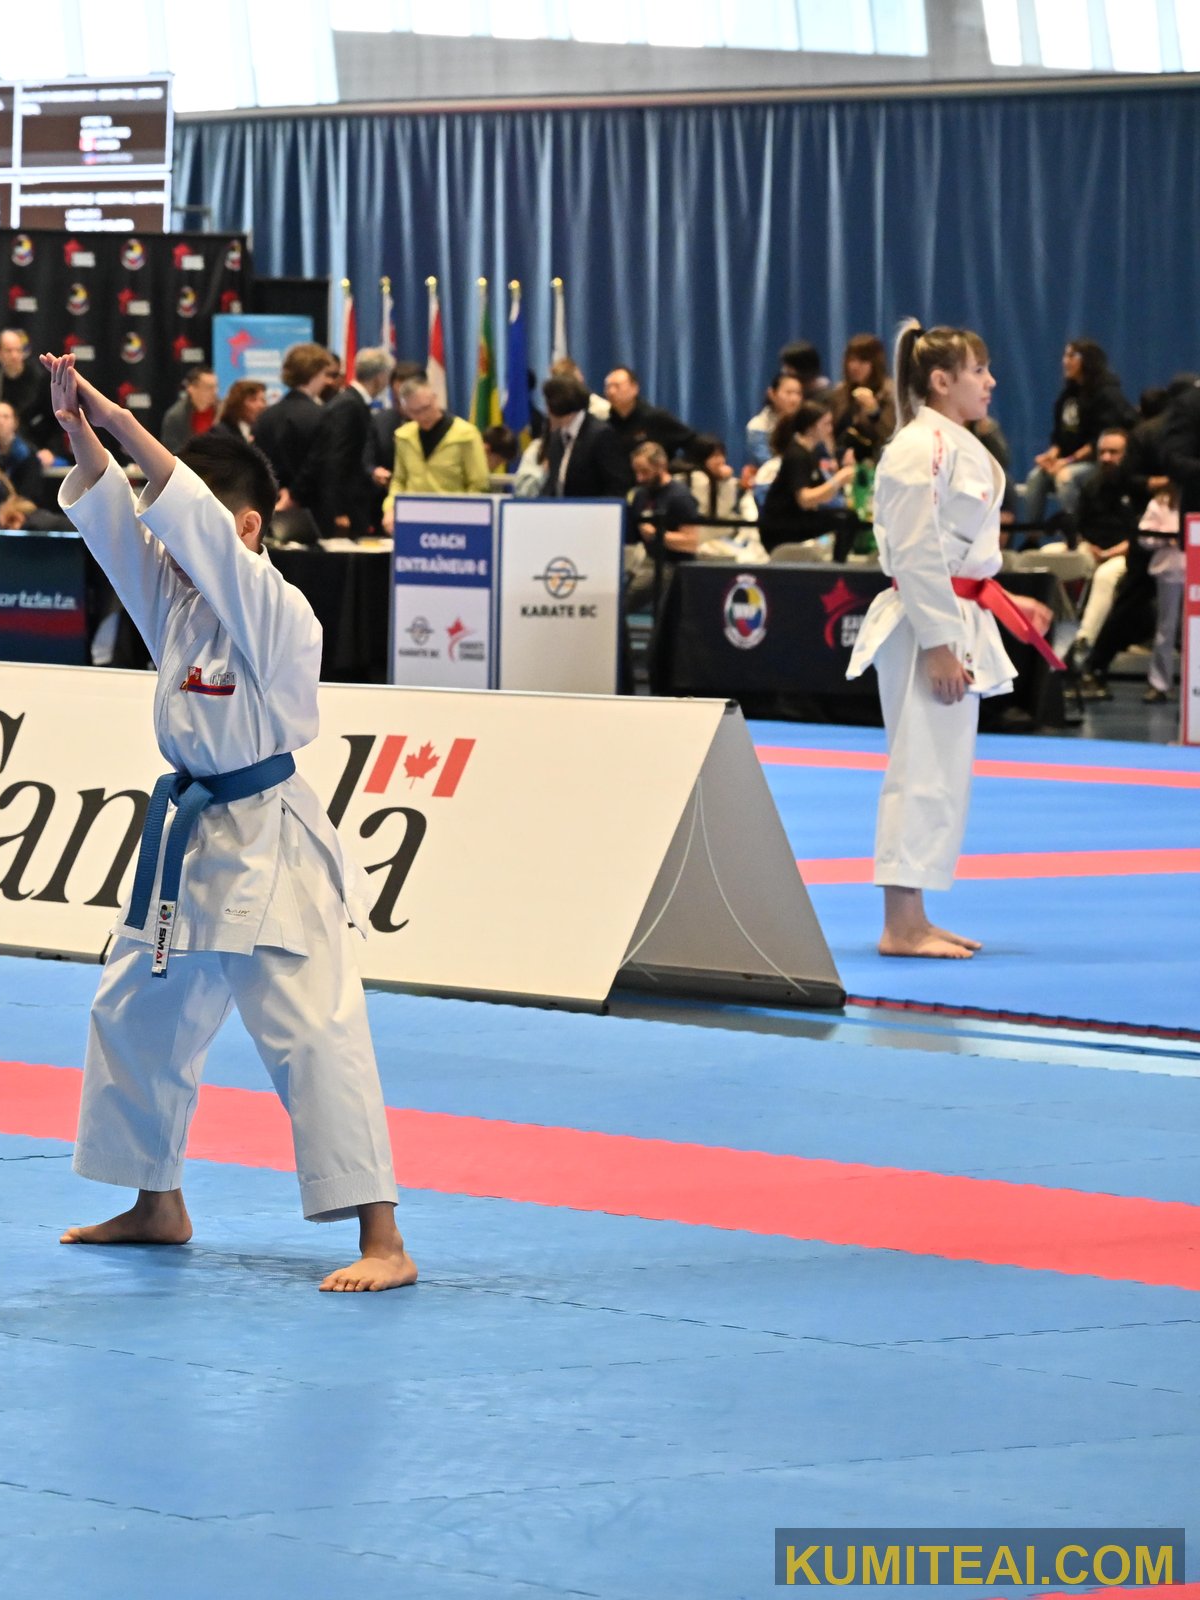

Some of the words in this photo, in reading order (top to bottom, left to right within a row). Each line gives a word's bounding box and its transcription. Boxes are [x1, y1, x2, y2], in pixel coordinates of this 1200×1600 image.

[420, 532, 466, 550] COACH
[521, 604, 574, 617] KARATE
[579, 604, 597, 617] BC
[155, 927, 167, 964] SMAI
